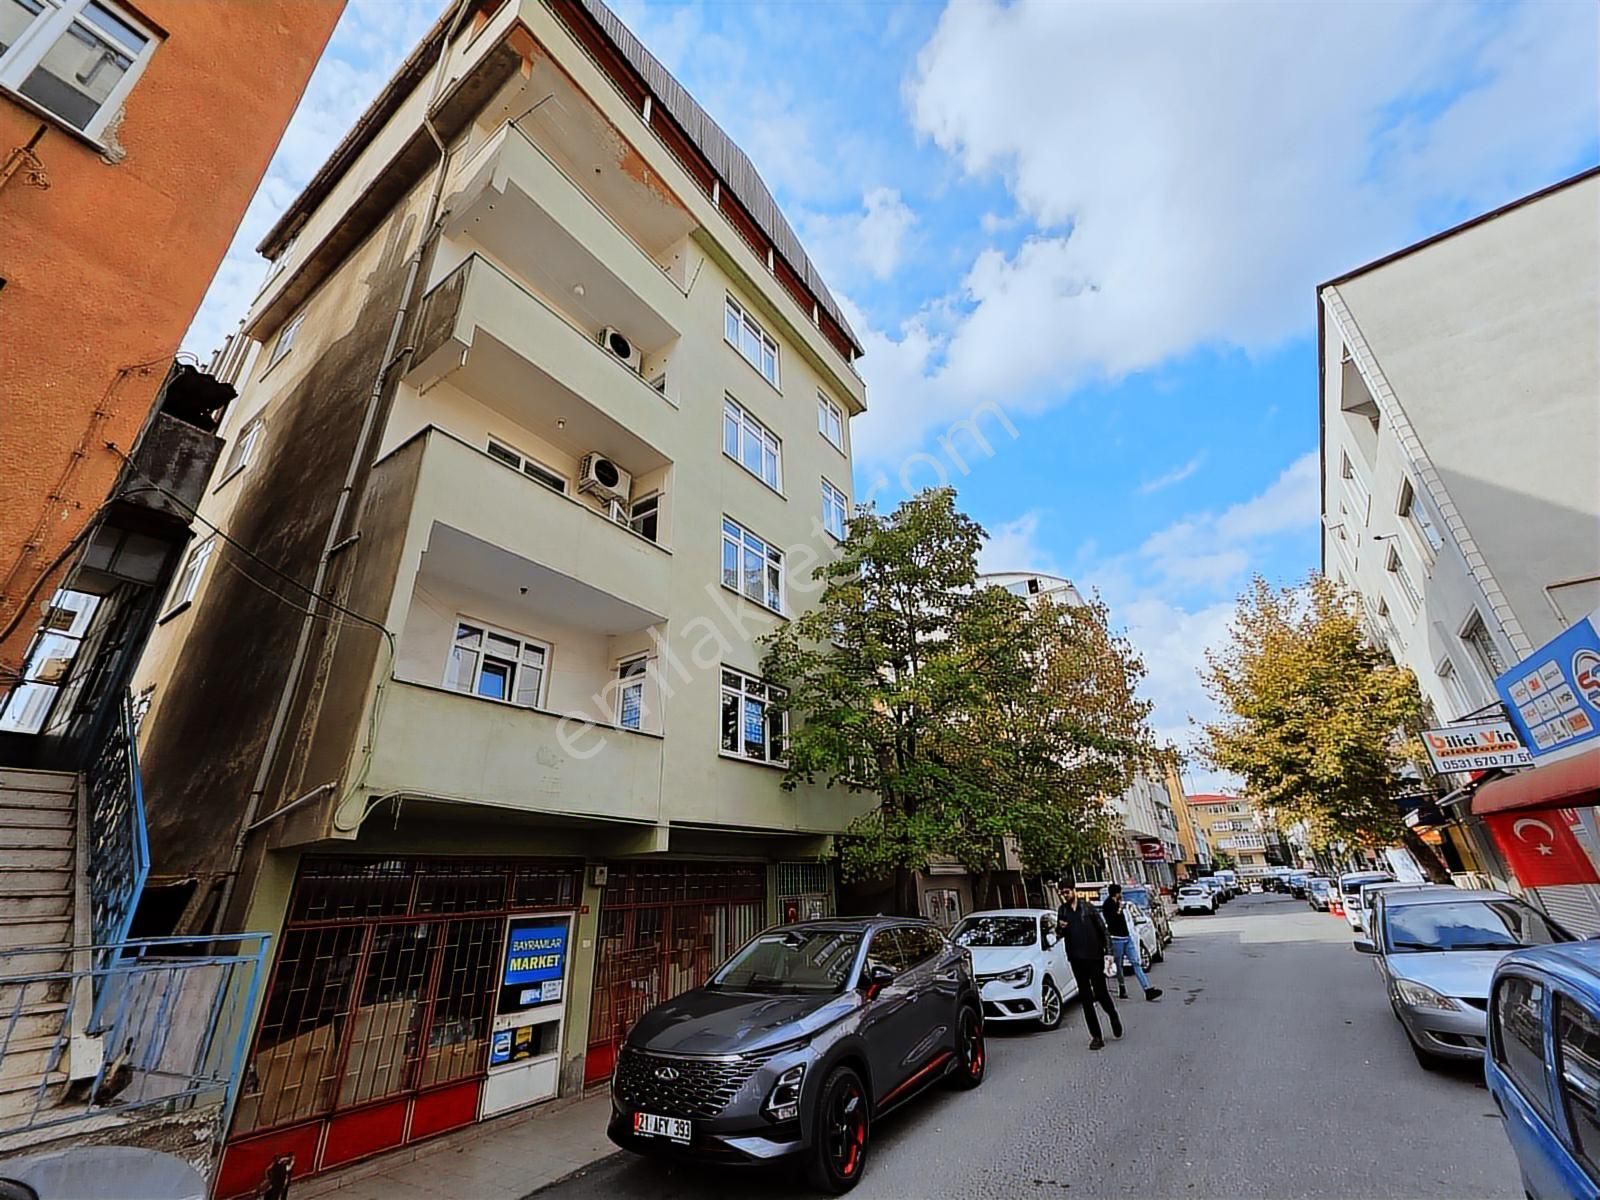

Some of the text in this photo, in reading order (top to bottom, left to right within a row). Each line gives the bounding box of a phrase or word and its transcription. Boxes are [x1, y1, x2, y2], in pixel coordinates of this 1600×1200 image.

[1443, 760, 1472, 770] 0531
[1475, 756, 1498, 767] 670
[1500, 754, 1514, 764] 77
[510, 954, 560, 971] MARKET
[639, 1114, 649, 1131] 21
[673, 1120, 690, 1138] 393
